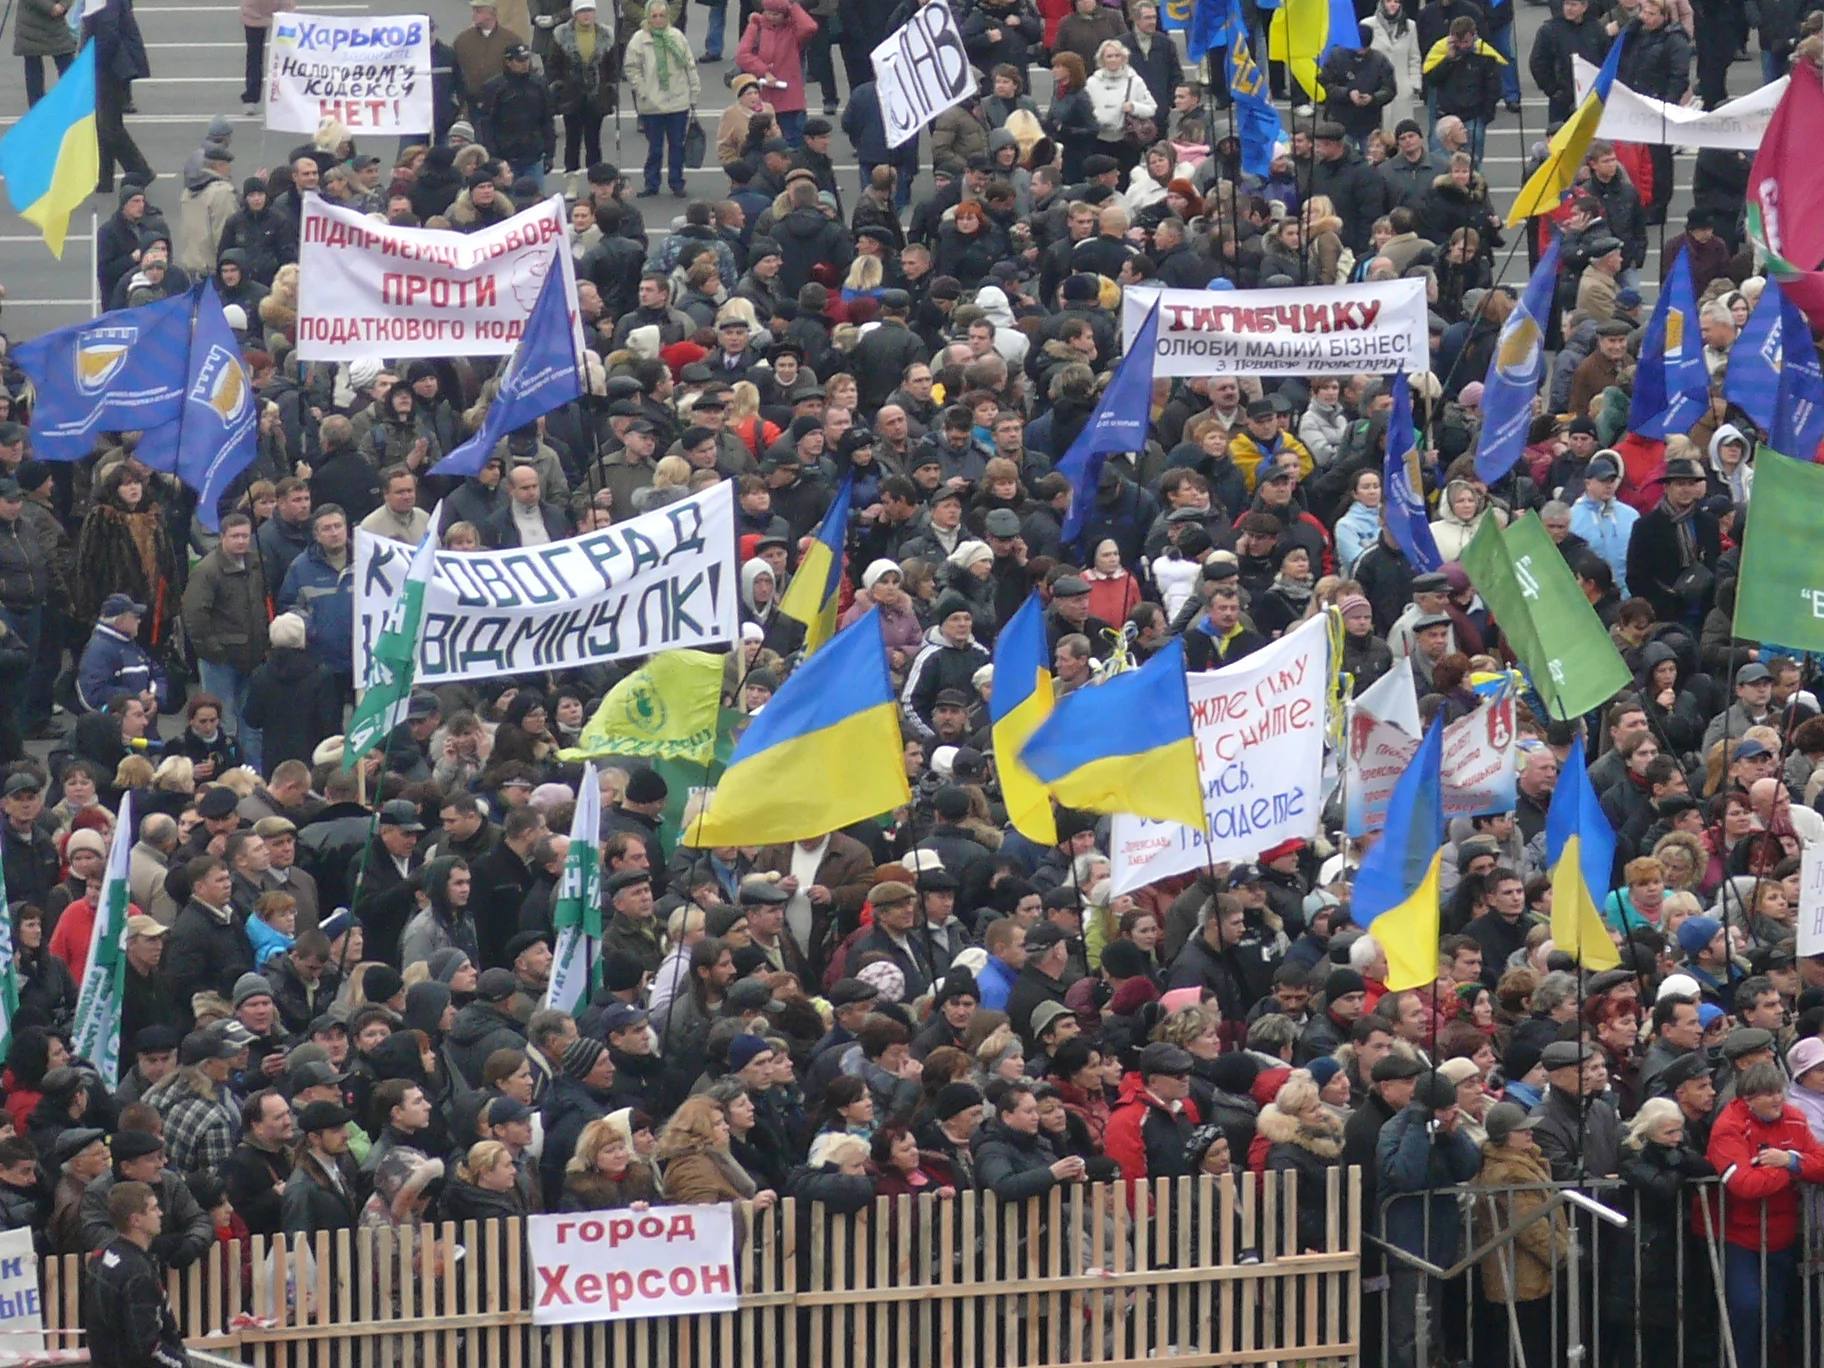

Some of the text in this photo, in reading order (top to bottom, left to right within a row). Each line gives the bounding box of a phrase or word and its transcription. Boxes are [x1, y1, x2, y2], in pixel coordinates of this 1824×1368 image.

[304, 216, 460, 269] ПІДПРИЄМЦІ
[381, 272, 497, 309] ПРОТИ
[299, 316, 465, 345] ПОДАТКОВОГО
[1156, 334, 1413, 359] ОЛЮБИ МАЛИЙ БІЗНЕС!
[420, 594, 629, 676] ВІДМІНУ
[636, 561, 722, 647] ПК!
[556, 1214, 697, 1249] город
[536, 1263, 731, 1312] Херсон
